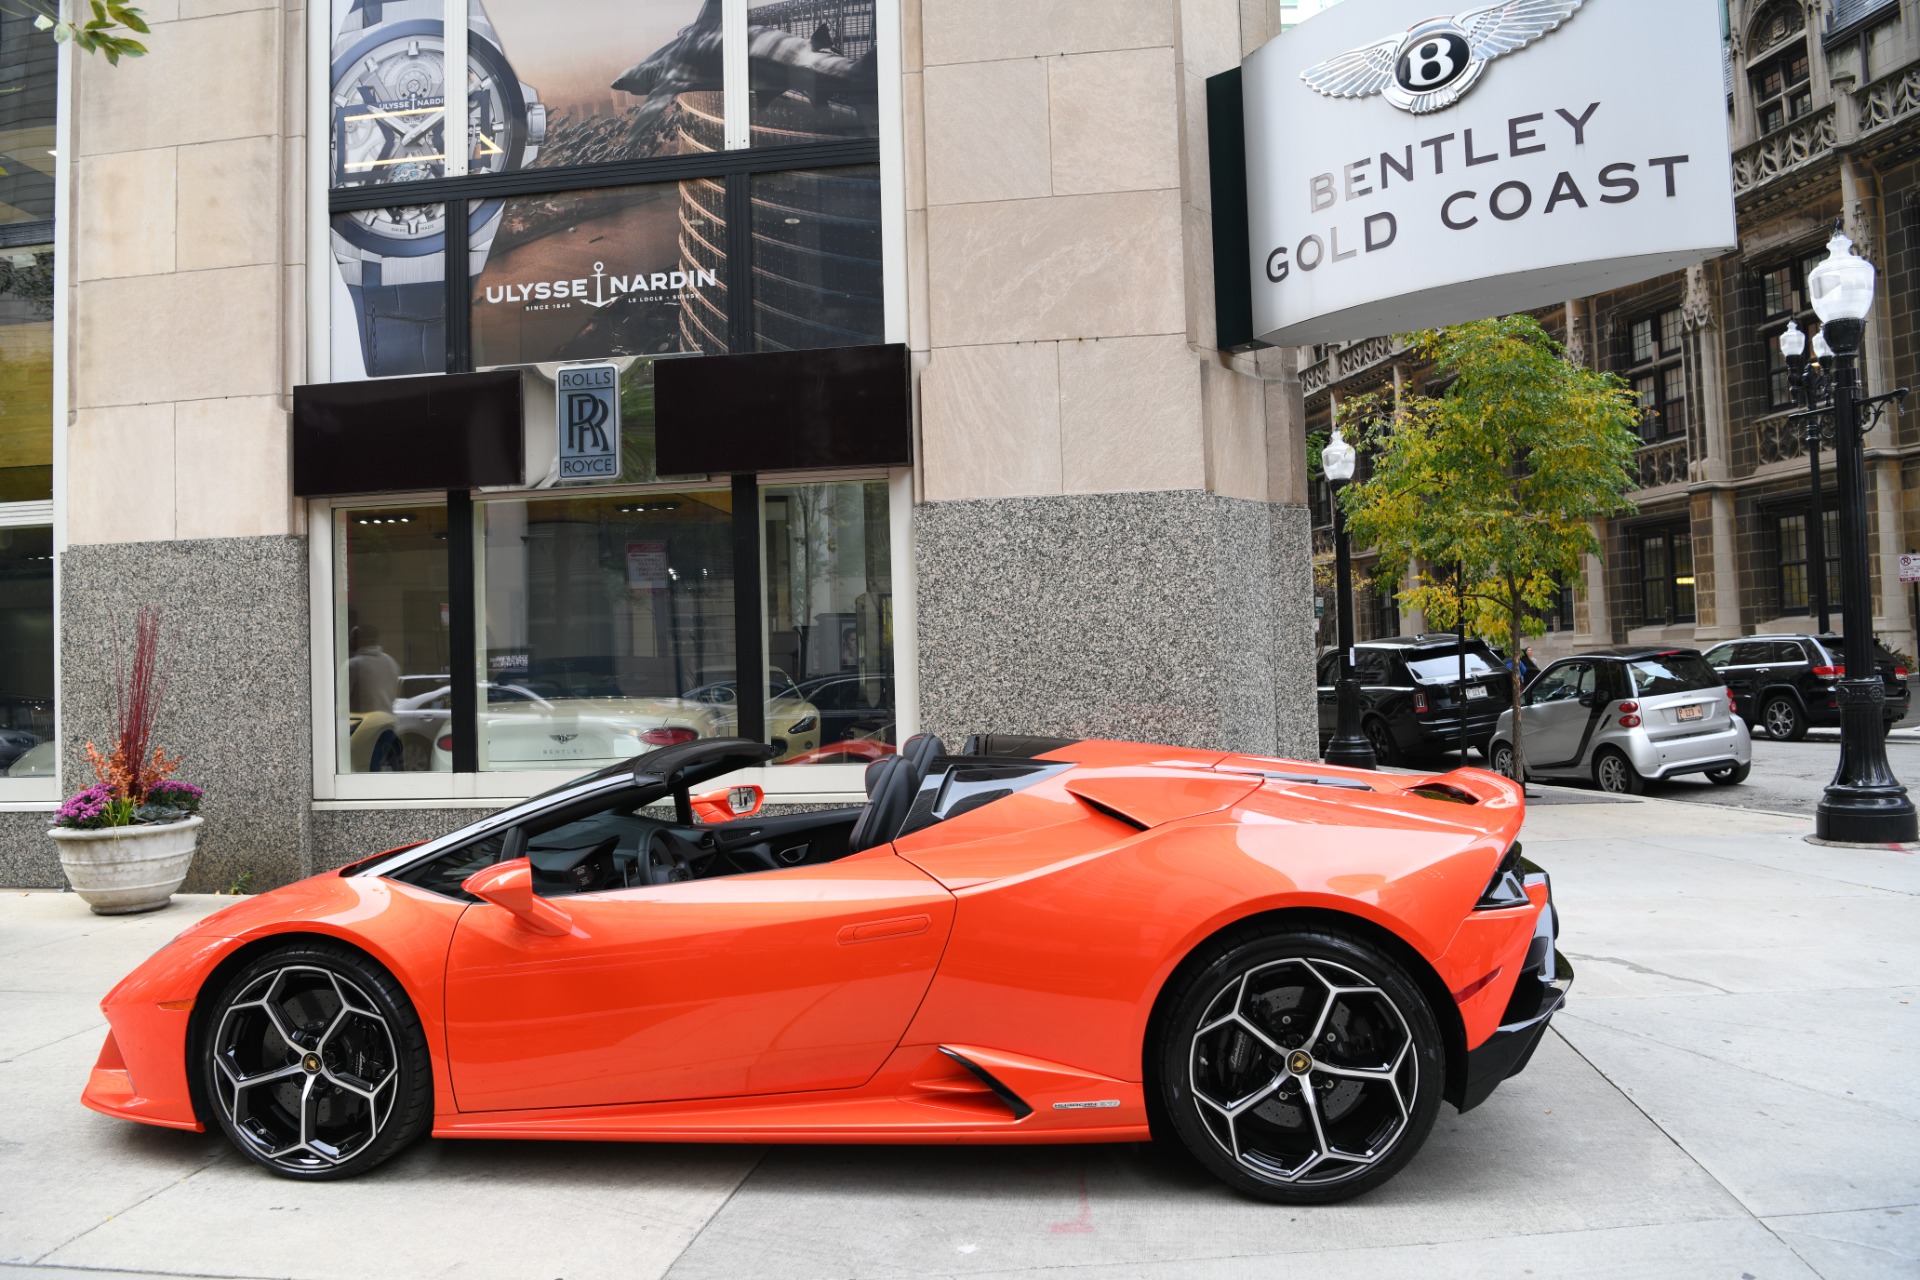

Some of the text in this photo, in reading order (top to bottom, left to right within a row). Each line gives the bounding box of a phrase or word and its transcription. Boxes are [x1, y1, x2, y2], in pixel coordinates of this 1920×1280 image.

[379, 98, 444, 110] ULYSSE NARDI
[1310, 101, 1601, 213] BENTLEY
[1266, 154, 1689, 283] GOLD COAST
[486, 269, 716, 304] ULYSSE NARDIN
[562, 372, 611, 386] ROLLS
[564, 459, 612, 473] ROYCE
